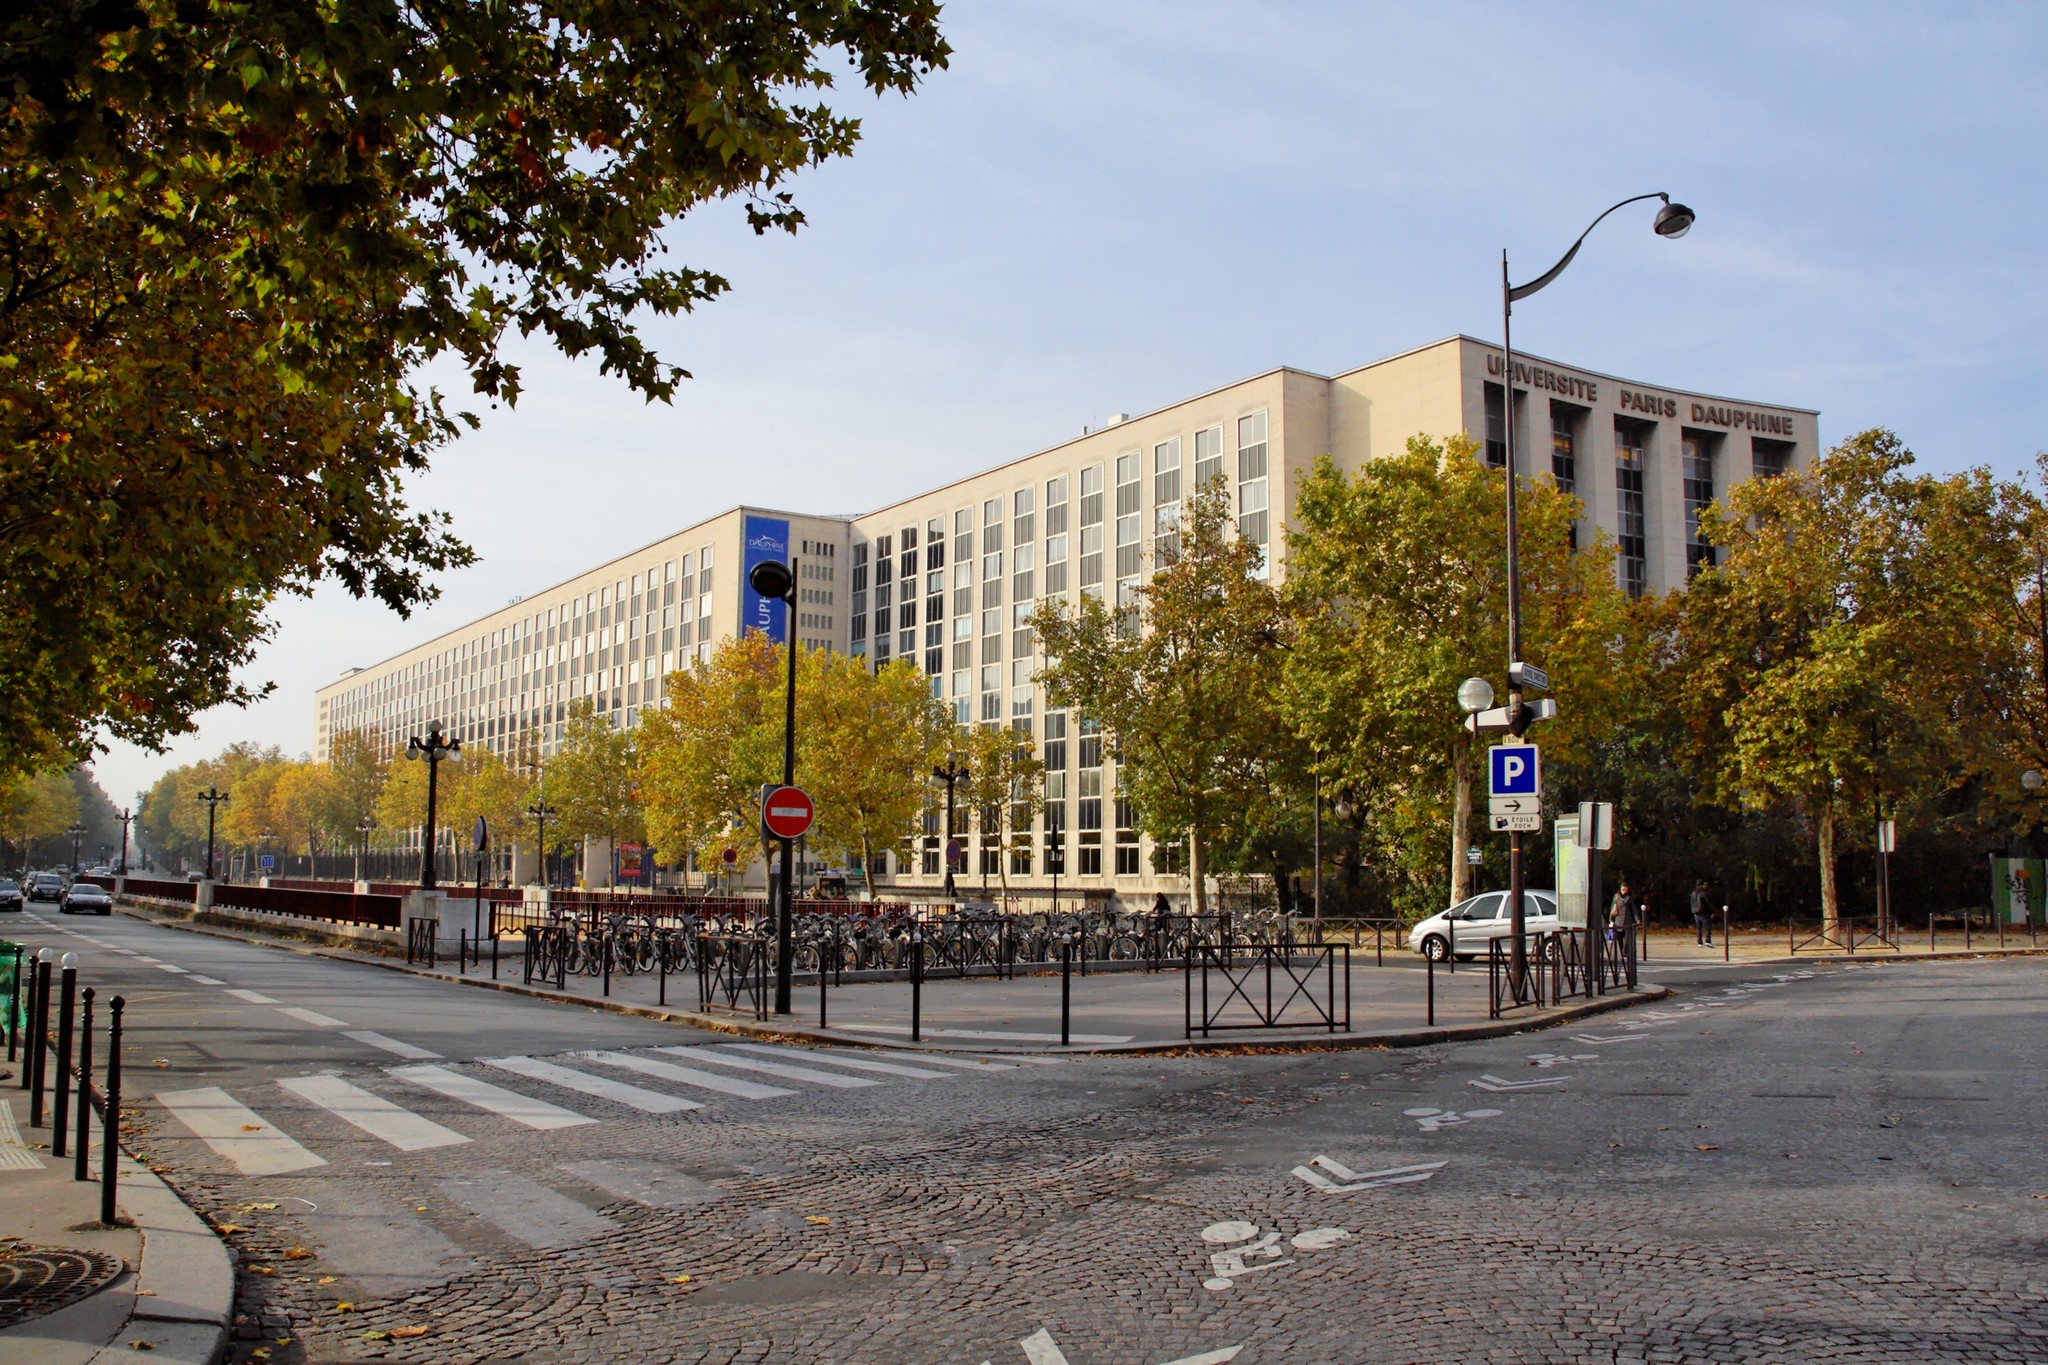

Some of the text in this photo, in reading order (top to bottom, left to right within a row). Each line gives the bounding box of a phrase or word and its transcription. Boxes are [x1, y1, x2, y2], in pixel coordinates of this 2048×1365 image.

[1620, 389, 1677, 418] PARIS
[1691, 403, 1793, 435] DAUPHINE
[749, 538, 785, 549] DAUPHINE
[1504, 755, 1524, 786] P
